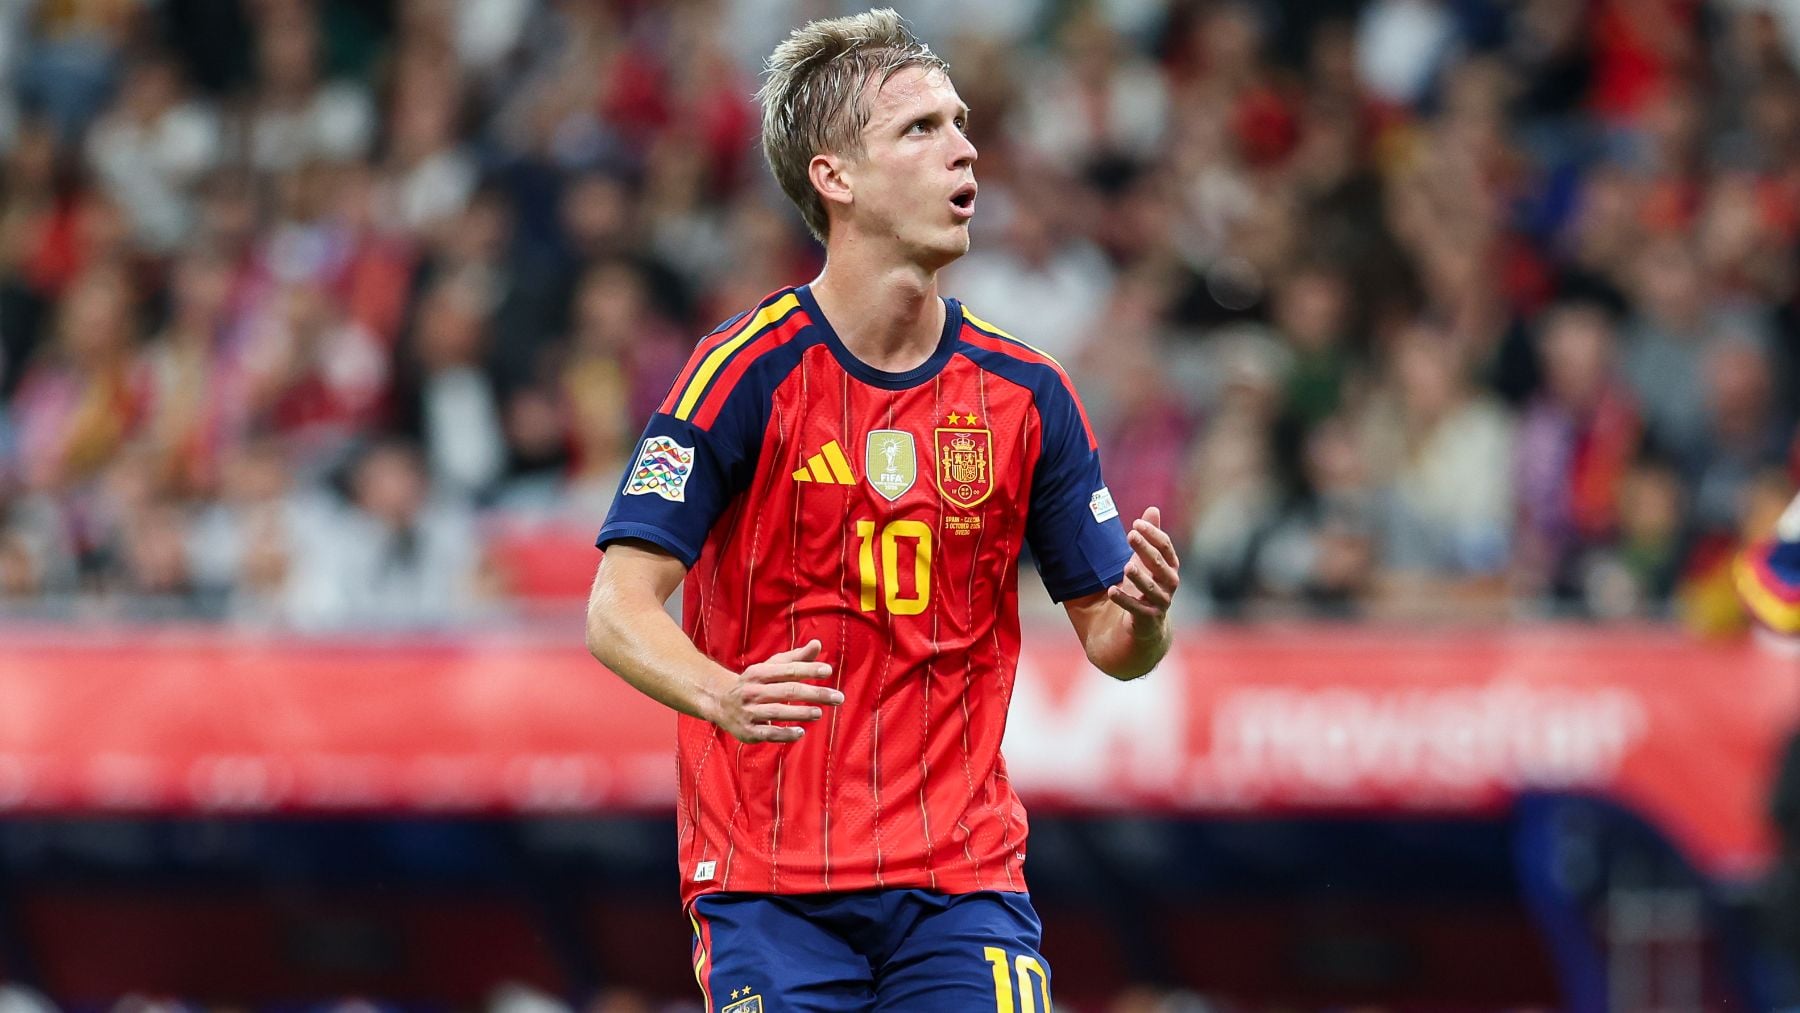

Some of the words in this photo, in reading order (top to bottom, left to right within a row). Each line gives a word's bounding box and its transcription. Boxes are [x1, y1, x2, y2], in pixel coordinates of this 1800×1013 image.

[880, 473, 902, 483] FIFA
[856, 519, 932, 615] 10
[983, 946, 1052, 1013] 10
